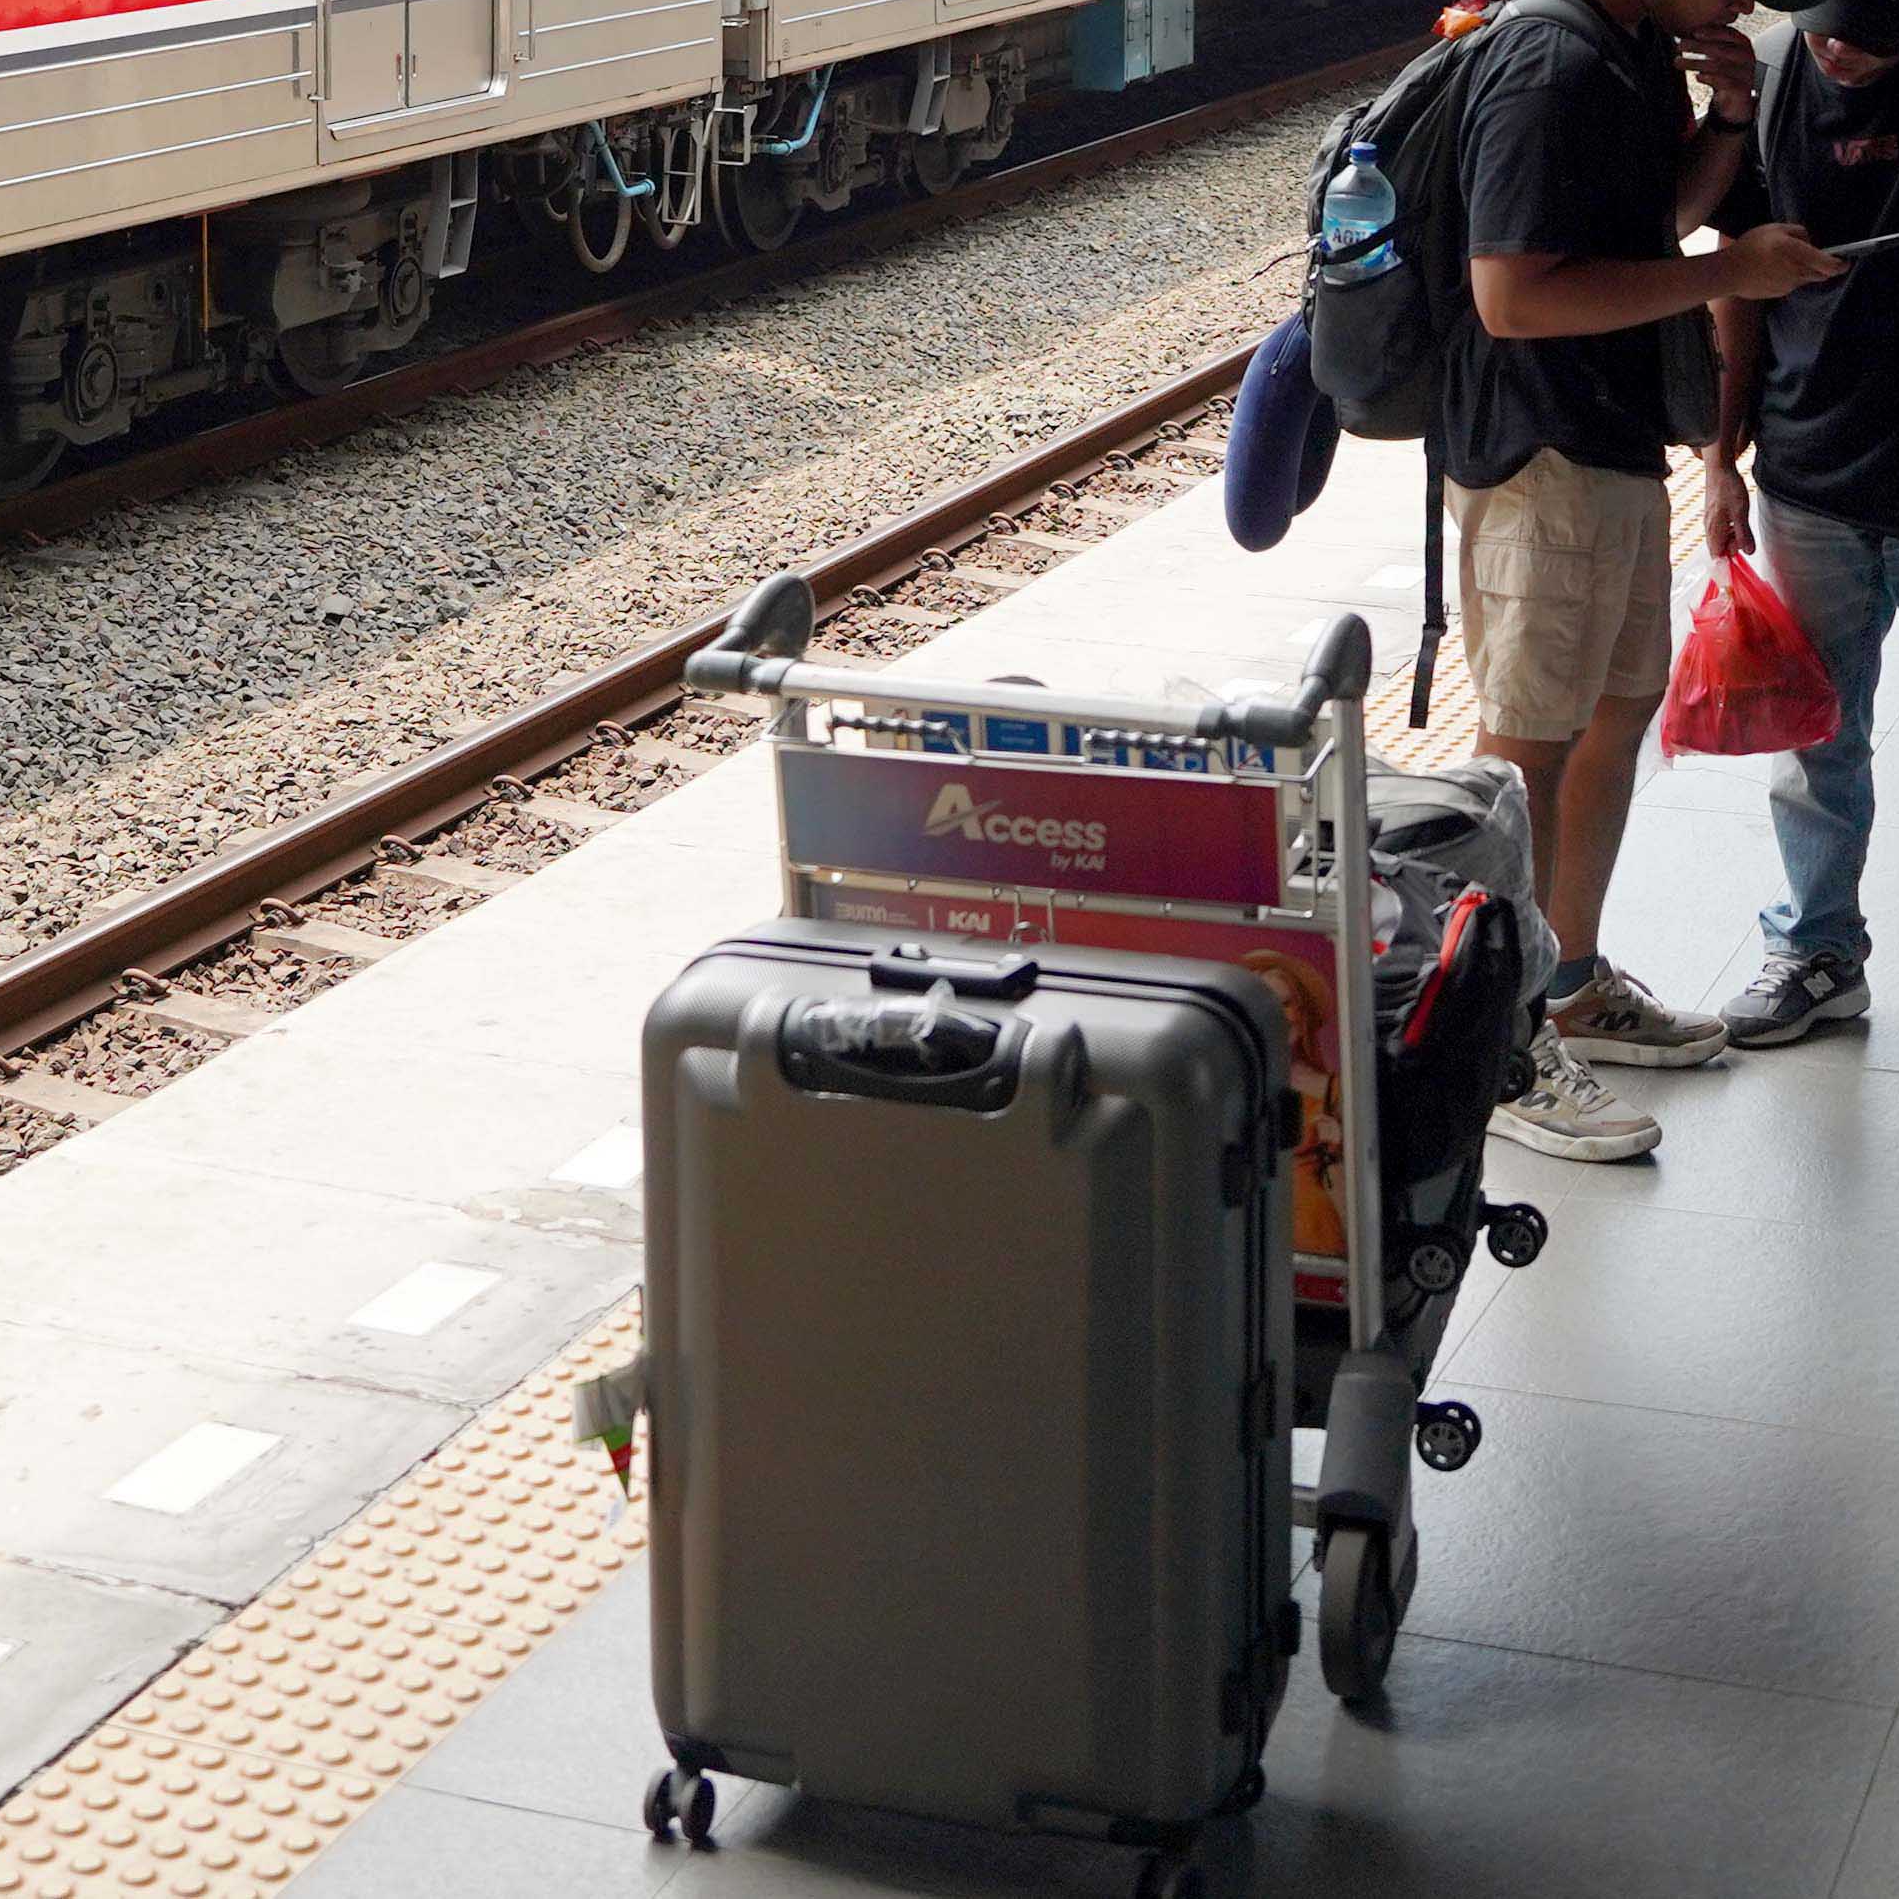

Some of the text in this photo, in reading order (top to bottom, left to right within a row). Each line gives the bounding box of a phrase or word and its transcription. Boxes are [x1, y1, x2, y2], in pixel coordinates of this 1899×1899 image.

[924, 783, 1108, 851] Access
[1051, 854, 1107, 872] by KAI
[947, 909, 992, 934] KAI
